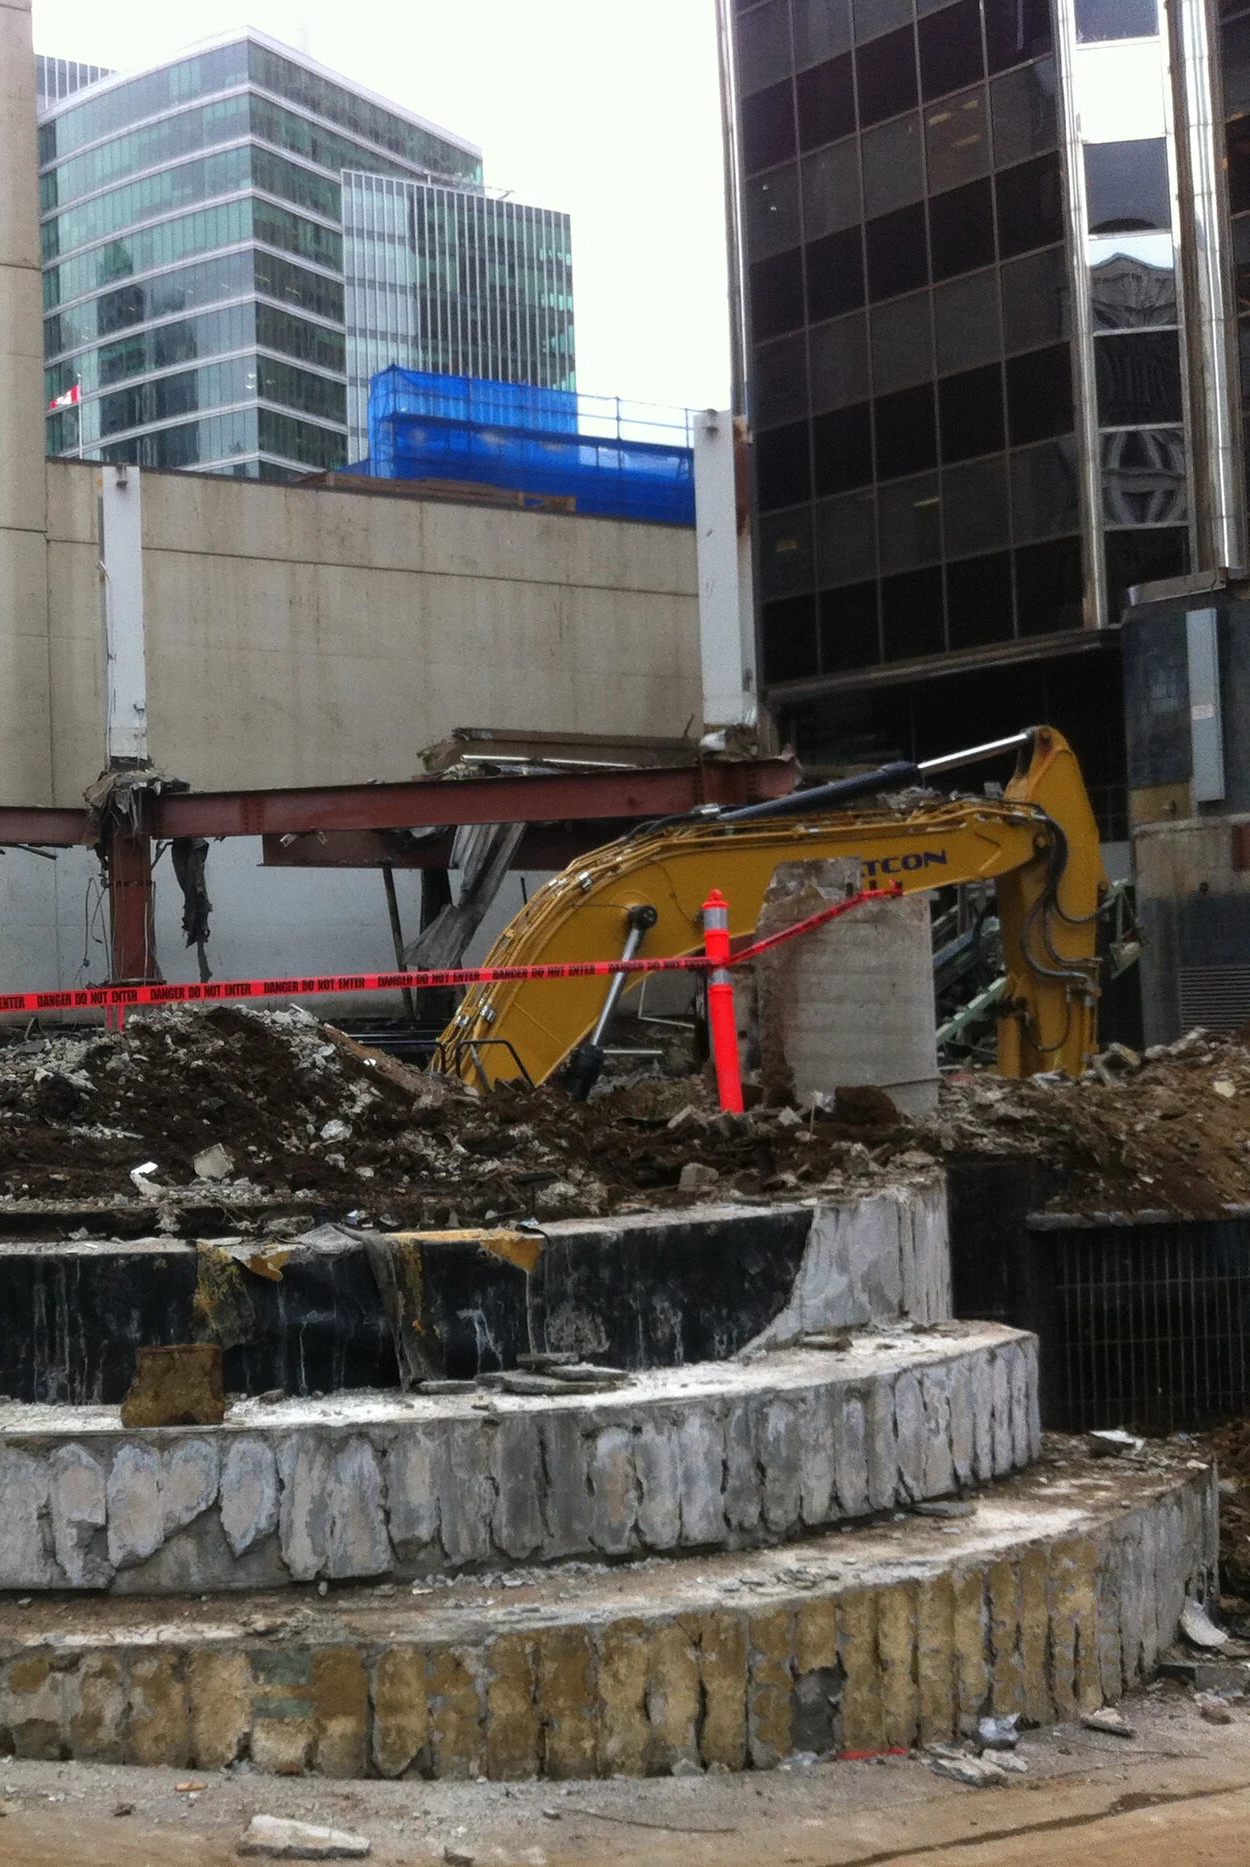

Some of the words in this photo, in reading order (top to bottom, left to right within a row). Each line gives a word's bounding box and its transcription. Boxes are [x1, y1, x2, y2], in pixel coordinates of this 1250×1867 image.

[861, 849, 948, 877] TCON
[377, 974, 413, 987] DANGER
[416, 973, 429, 985] DO
[432, 972, 450, 984] NOT
[453, 970, 481, 983] ENTER
[492, 967, 528, 980] DANGER
[531, 967, 544, 978] DO
[547, 966, 565, 978] NOT
[568, 965, 596, 977] ENTER
[150, 987, 185, 1000] DANGER
[188, 986, 200, 998] DO
[204, 985, 221, 997] NOT
[225, 983, 251, 996] ENTER
[263, 981, 298, 994] DANGER
[302, 980, 315, 992] DO
[318, 978, 336, 991] NOT
[338, 977, 365, 989] ENTER
[37, 994, 72, 1007] DANGER
[75, 993, 88, 1005] DO
[90, 991, 108, 1004] NOT
[112, 990, 138, 1003] ENTER
